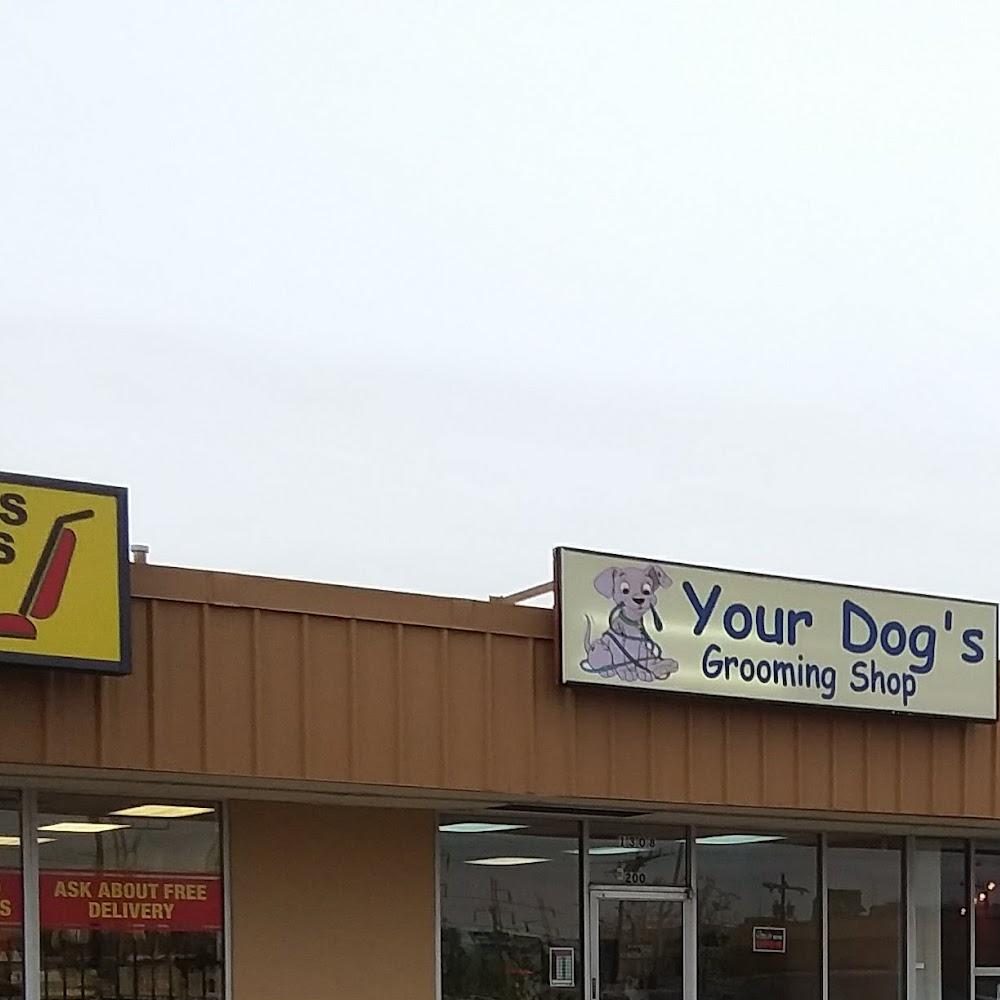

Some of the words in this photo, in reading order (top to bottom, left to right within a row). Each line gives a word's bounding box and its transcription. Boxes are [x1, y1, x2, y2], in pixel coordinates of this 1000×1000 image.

[682, 580, 814, 646] Your
[842, 599, 985, 674] Dog's
[701, 643, 838, 700] Grooming
[849, 660, 918, 706] Shop
[620, 837, 656, 848] 1308
[625, 873, 646, 883] 200
[54, 881, 92, 898] ASK
[98, 882, 159, 899] ABOUT
[164, 884, 208, 901] FREE
[88, 901, 175, 920] DELIVERY
